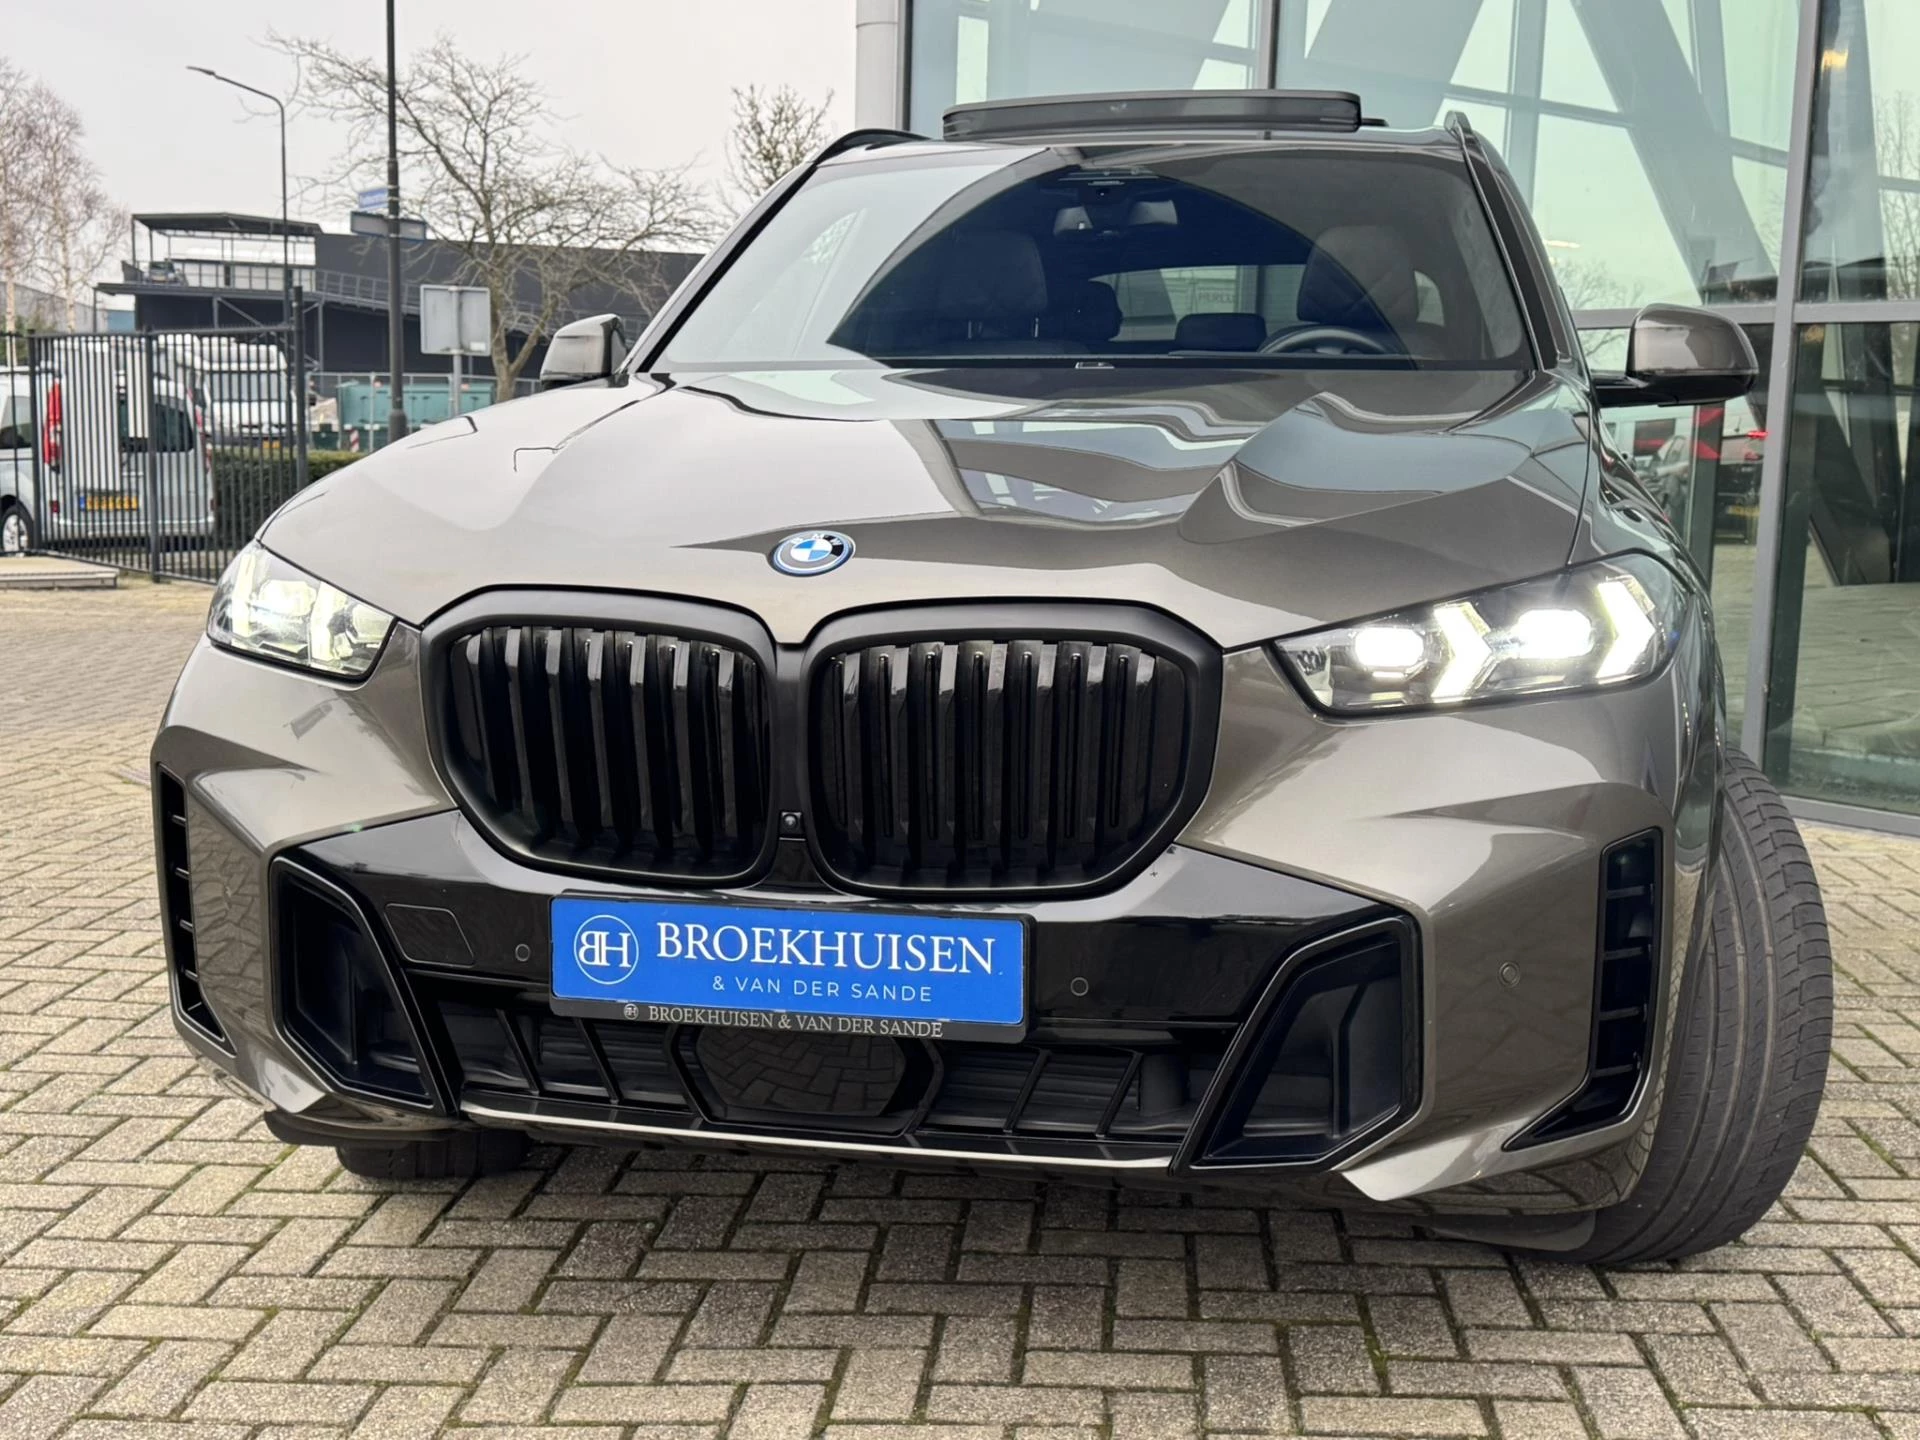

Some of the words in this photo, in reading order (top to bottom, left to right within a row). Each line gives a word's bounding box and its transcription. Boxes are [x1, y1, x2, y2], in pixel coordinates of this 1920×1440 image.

[657, 922, 996, 975] BROEKHUISEN
[712, 975, 725, 991] &
[735, 977, 781, 993] VAN
[793, 980, 840, 997] DER
[851, 983, 932, 1002] SANDE
[648, 1006, 773, 1028] BROEKHUISEN
[778, 1014, 792, 1029] &
[796, 1015, 832, 1031] VAN
[838, 1018, 876, 1034] DER
[880, 1019, 943, 1038] SANDE
